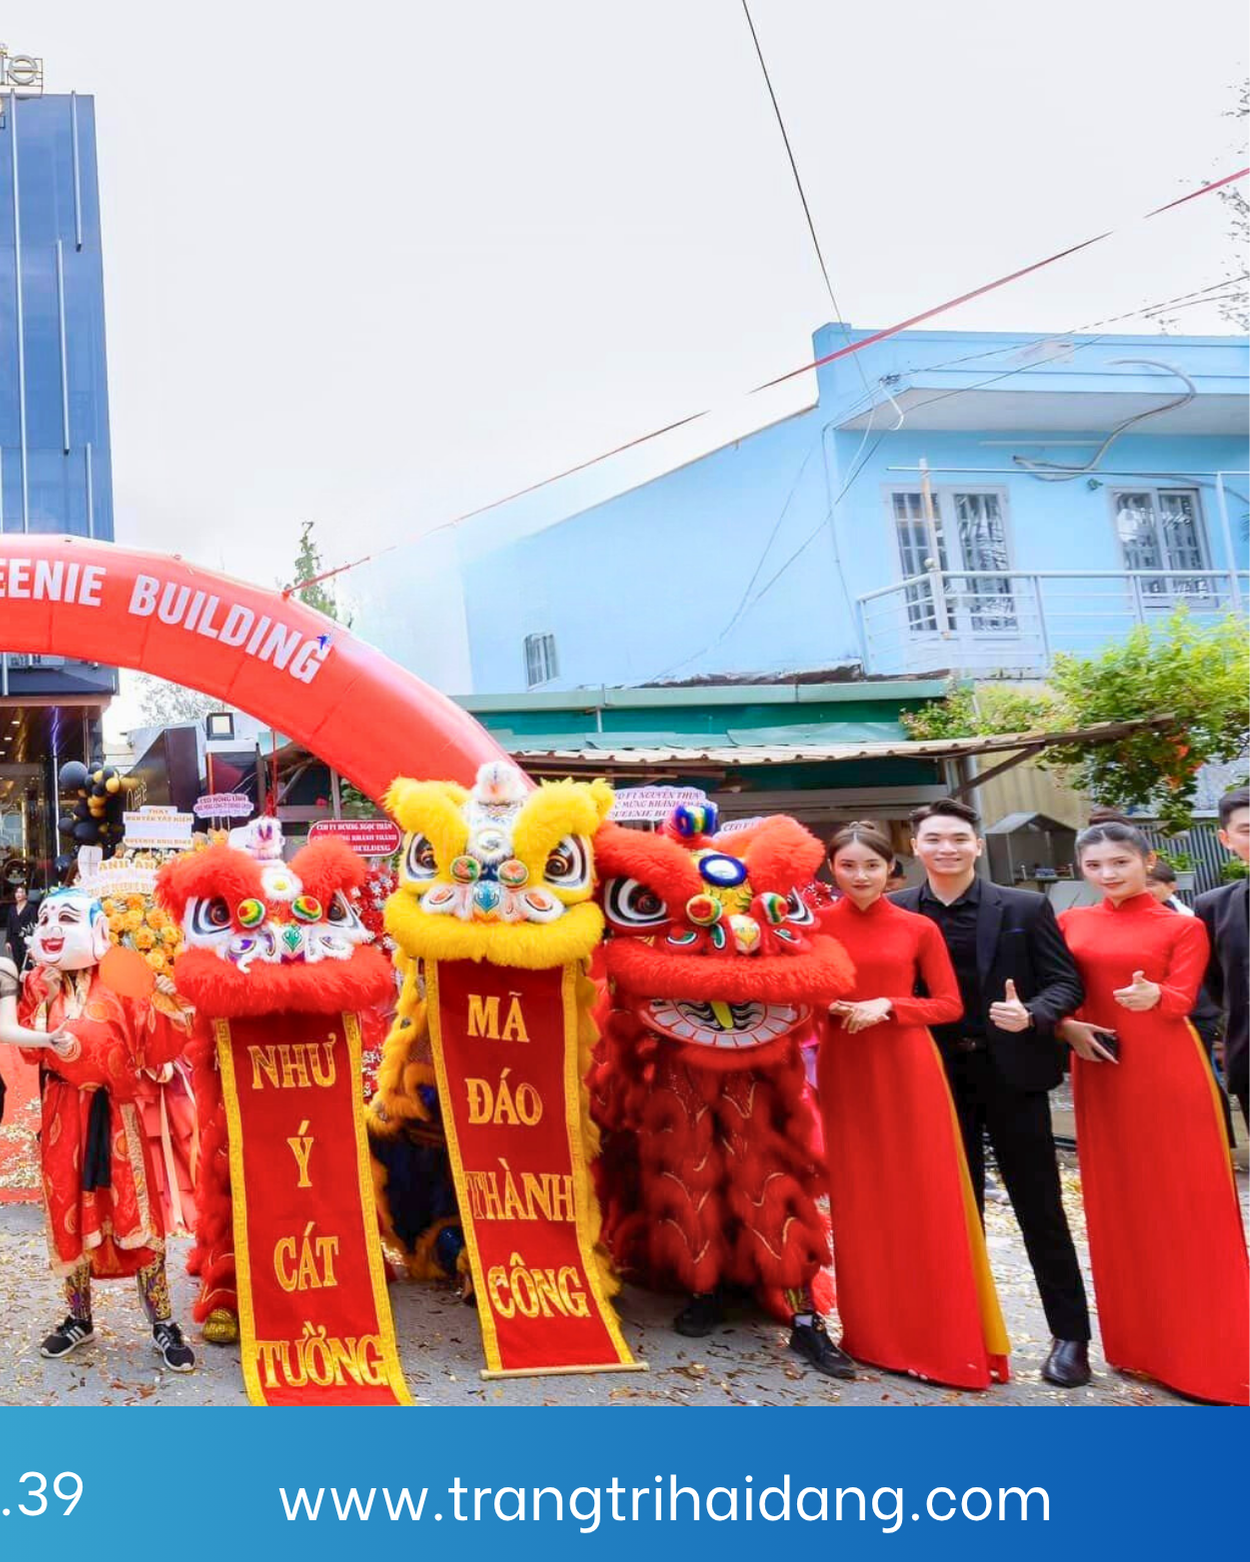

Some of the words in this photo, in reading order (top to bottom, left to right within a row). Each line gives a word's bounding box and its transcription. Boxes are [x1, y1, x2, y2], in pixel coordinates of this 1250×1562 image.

[129, 574, 333, 684] BUILDING
[466, 991, 530, 1043] MÃ
[247, 1033, 337, 1089] NHƯ
[465, 1067, 543, 1126] ĐÁO
[287, 1120, 314, 1188] Ý
[464, 1157, 576, 1221] THÀNH
[273, 1221, 339, 1292] CÁT
[487, 1252, 591, 1319] CÔNG
[256, 1321, 390, 1388] TƯỜNG
